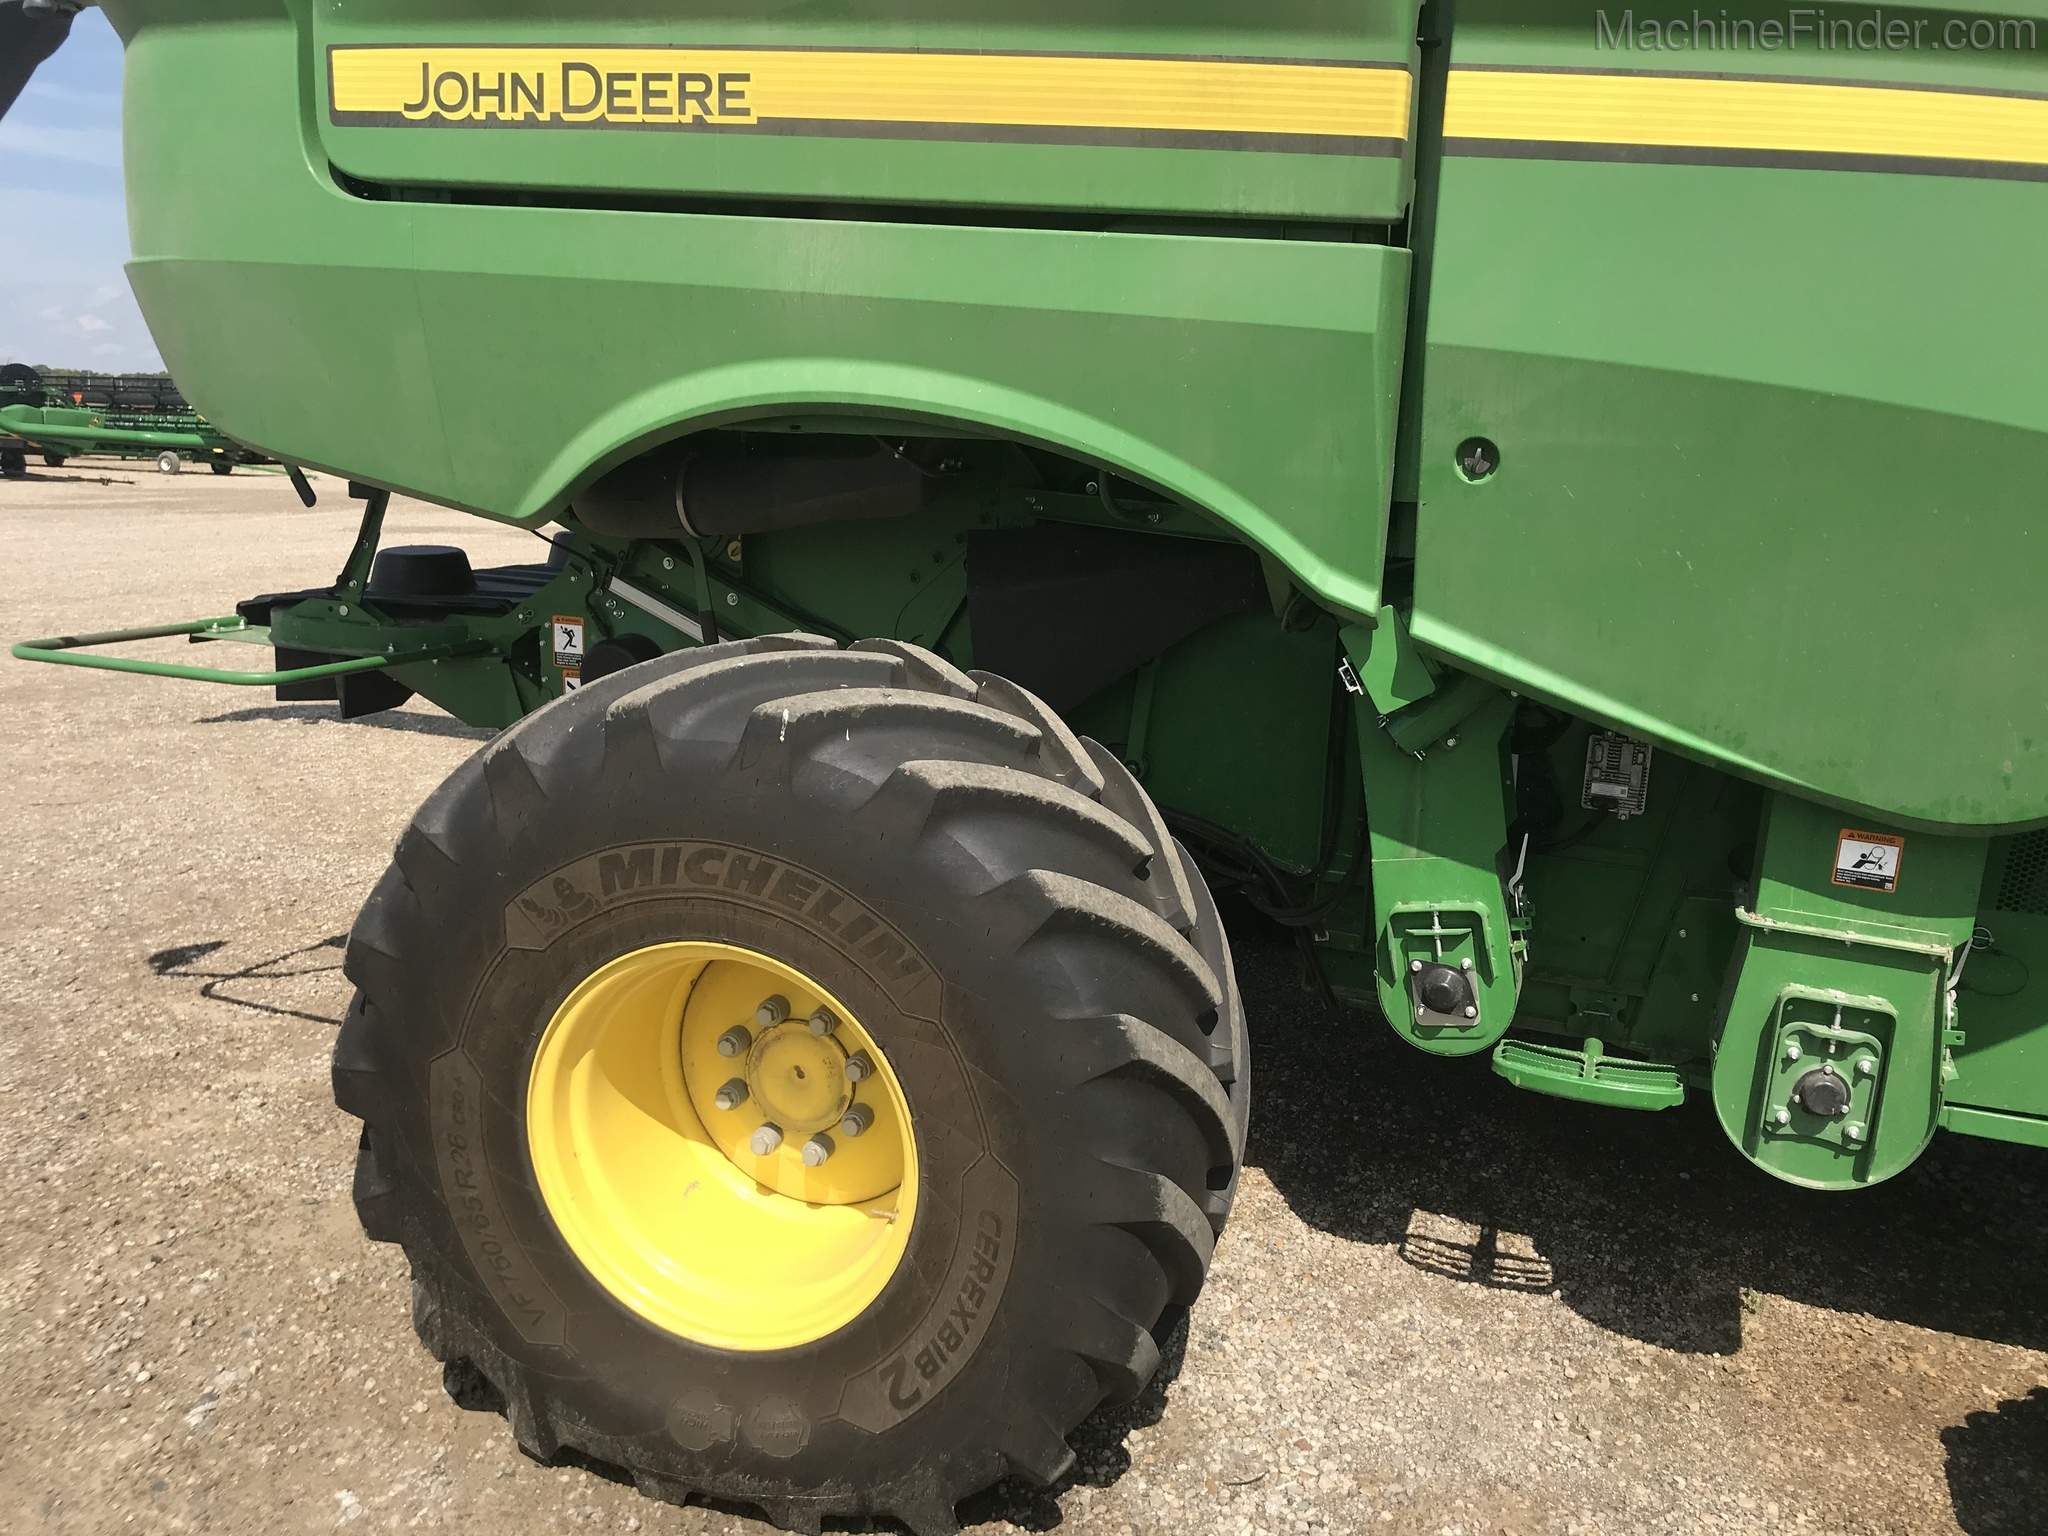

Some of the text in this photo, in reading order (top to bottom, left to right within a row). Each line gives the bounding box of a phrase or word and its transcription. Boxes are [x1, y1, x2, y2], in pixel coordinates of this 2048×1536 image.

[403, 61, 752, 117] JOHN DEERE
[1856, 832, 1896, 844] WARNING
[598, 846, 927, 982] MICHELIN
[878, 1208, 1002, 1411] CEREXBIB 2
